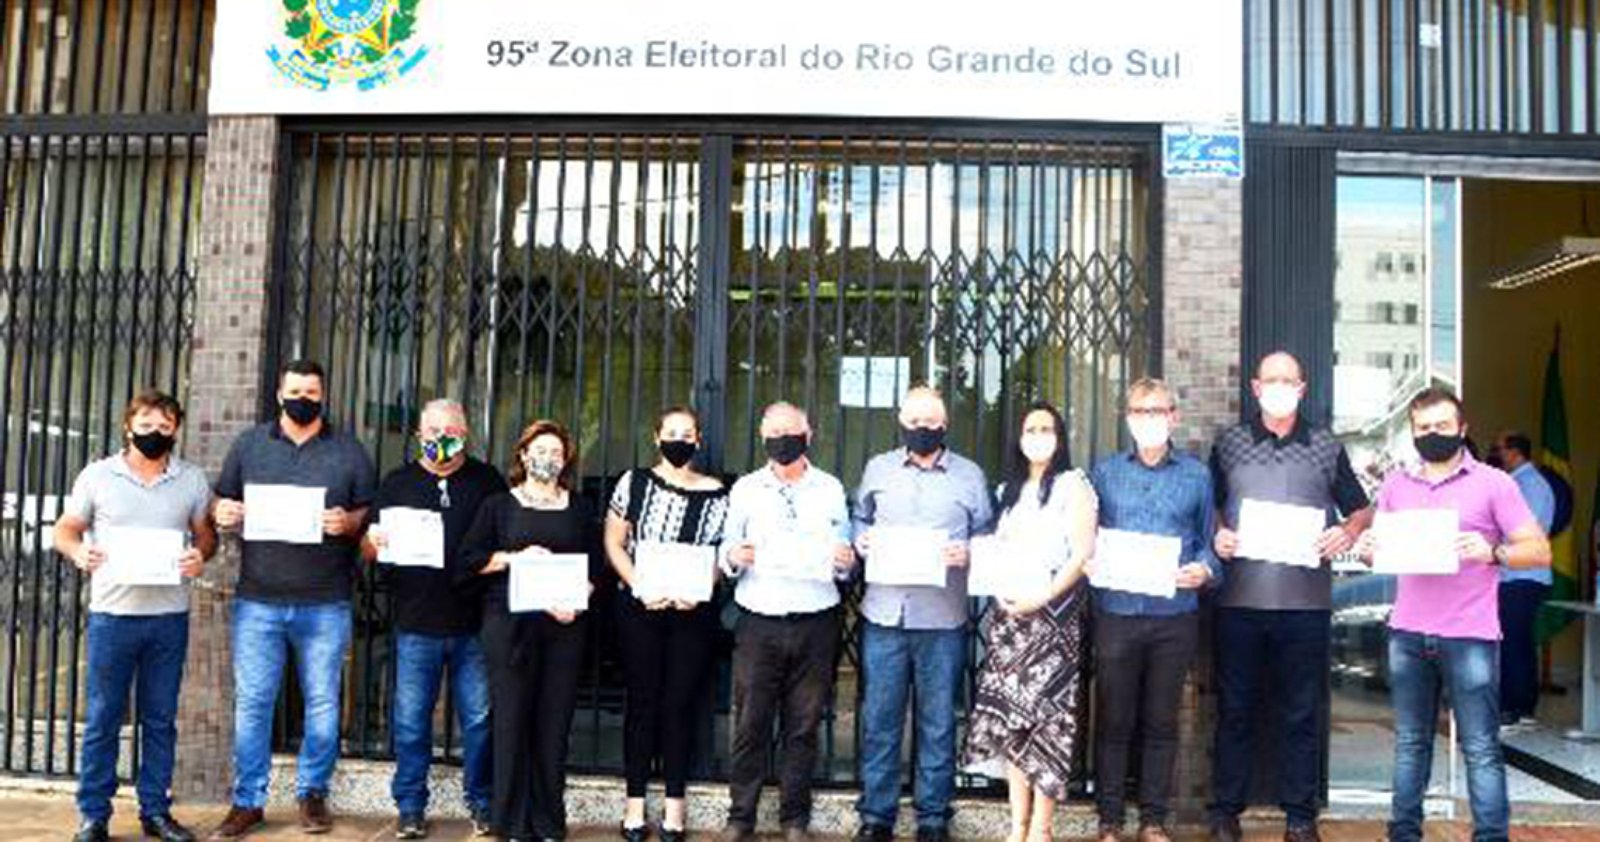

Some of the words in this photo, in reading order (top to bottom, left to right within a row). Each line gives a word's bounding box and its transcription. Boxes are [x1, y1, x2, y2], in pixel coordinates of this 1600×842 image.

[549, 40, 633, 68] Zona
[645, 40, 786, 69] Eleitoral
[800, 44, 844, 71] do
[855, 43, 914, 71] Rio
[927, 45, 1056, 74] Grande
[1069, 50, 1112, 76] do
[1126, 49, 1181, 79] Sul
